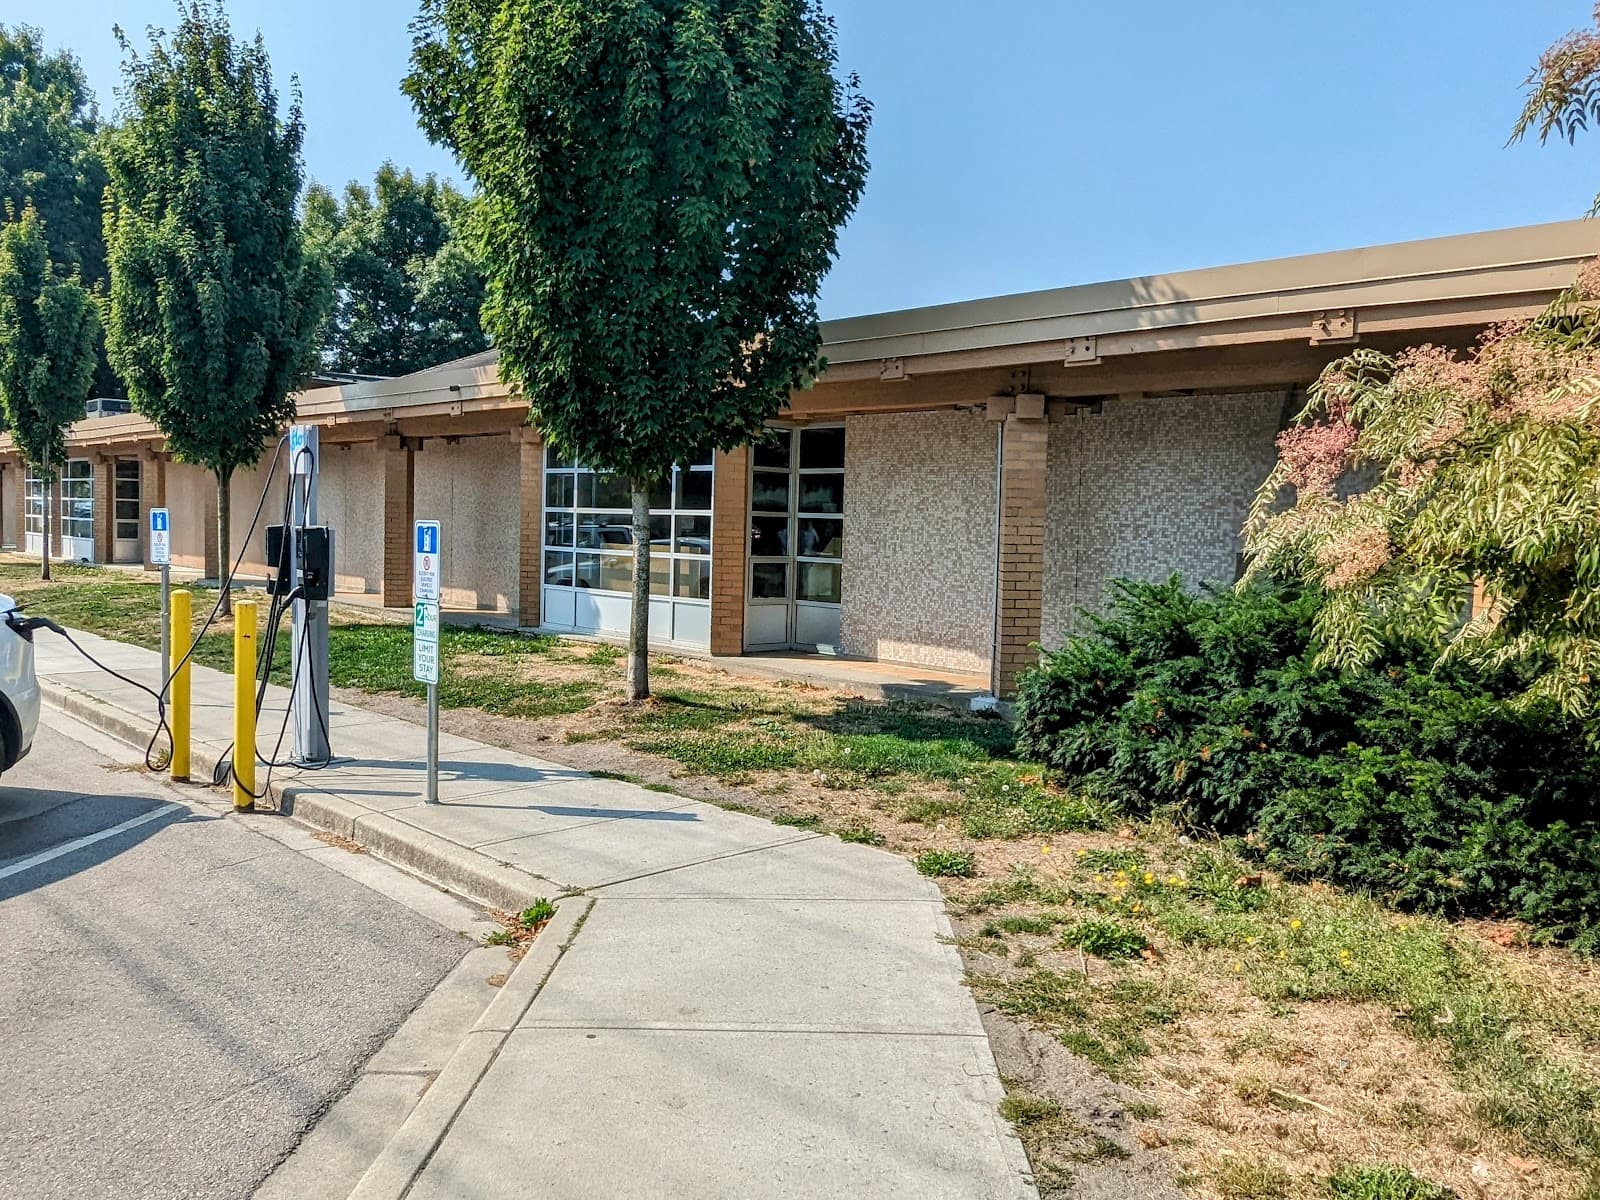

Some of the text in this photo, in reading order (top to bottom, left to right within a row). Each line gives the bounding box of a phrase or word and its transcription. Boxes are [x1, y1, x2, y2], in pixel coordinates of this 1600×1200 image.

[416, 604, 424, 625] 2
[418, 643, 434, 653] LIMIT
[418, 653, 435, 665] YOUR
[419, 663, 434, 673] STAY
